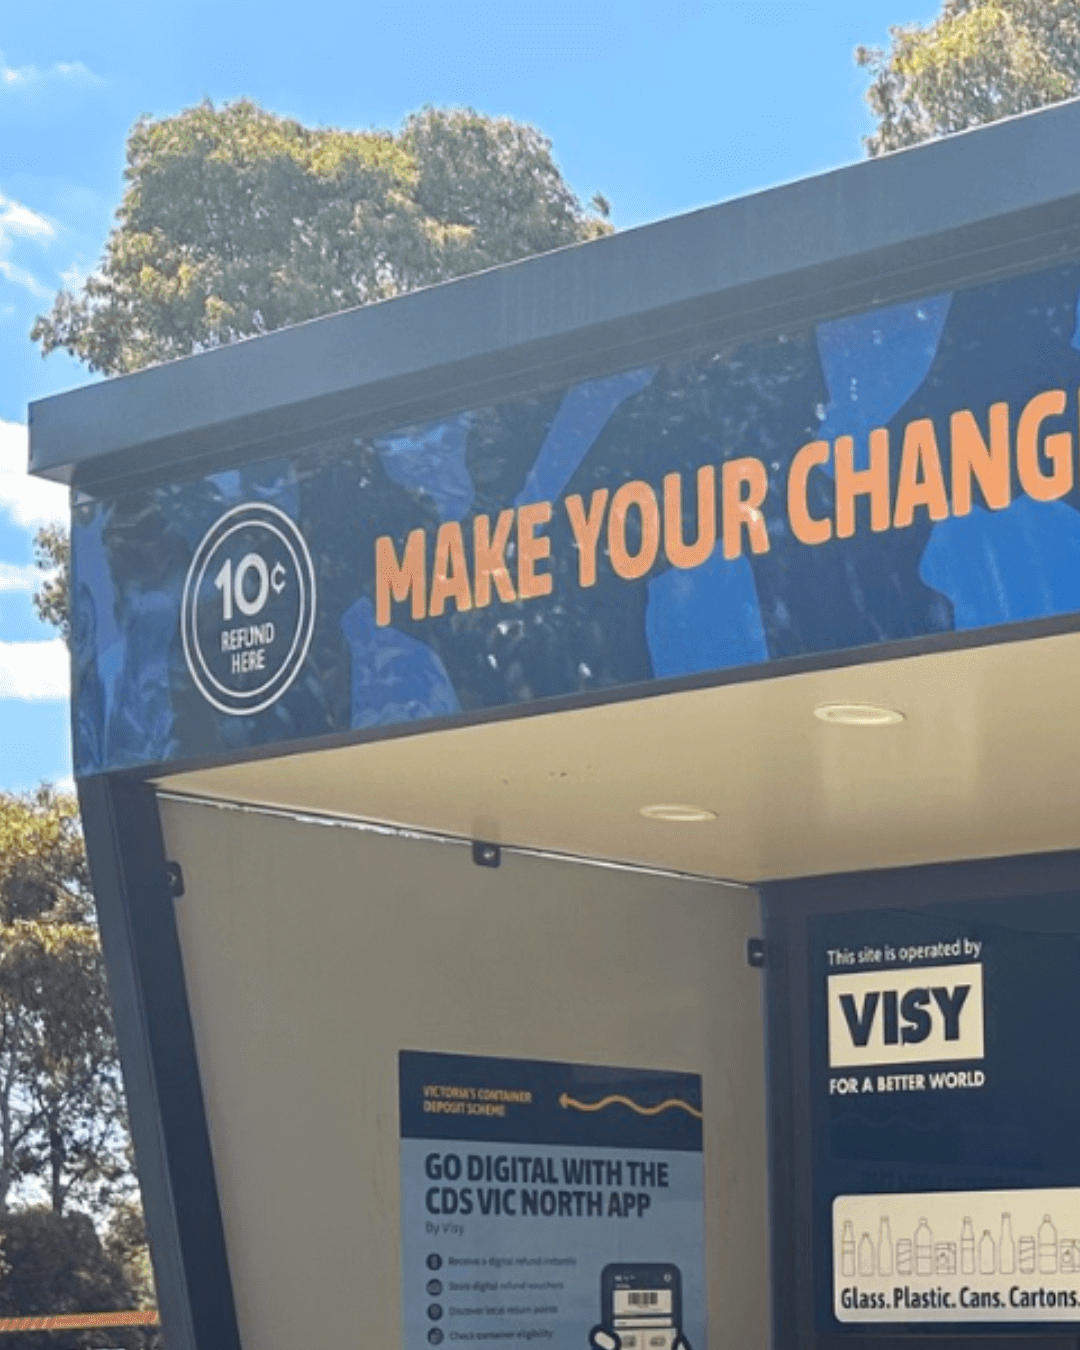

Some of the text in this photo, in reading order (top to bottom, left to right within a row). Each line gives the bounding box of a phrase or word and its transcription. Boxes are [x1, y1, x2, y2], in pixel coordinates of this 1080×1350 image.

[374, 500, 553, 627] MAKE
[565, 456, 770, 587] YOUR
[222, 623, 274, 651] REFUND
[232, 650, 265, 674] HERE
[827, 938, 982, 965] This site is operated by
[839, 985, 971, 1047] VISY
[830, 1071, 985, 1094] FOR A BETTER WORLD
[425, 1153, 669, 1187] GO DIGITAL WITH THE
[425, 1186, 650, 1218] CDS VIC NORTH APP
[426, 1221, 464, 1237] By Visy
[841, 1286, 890, 1310] Glass.
[894, 1286, 956, 1309] Plastic.
[959, 1286, 1006, 1308] Cans.
